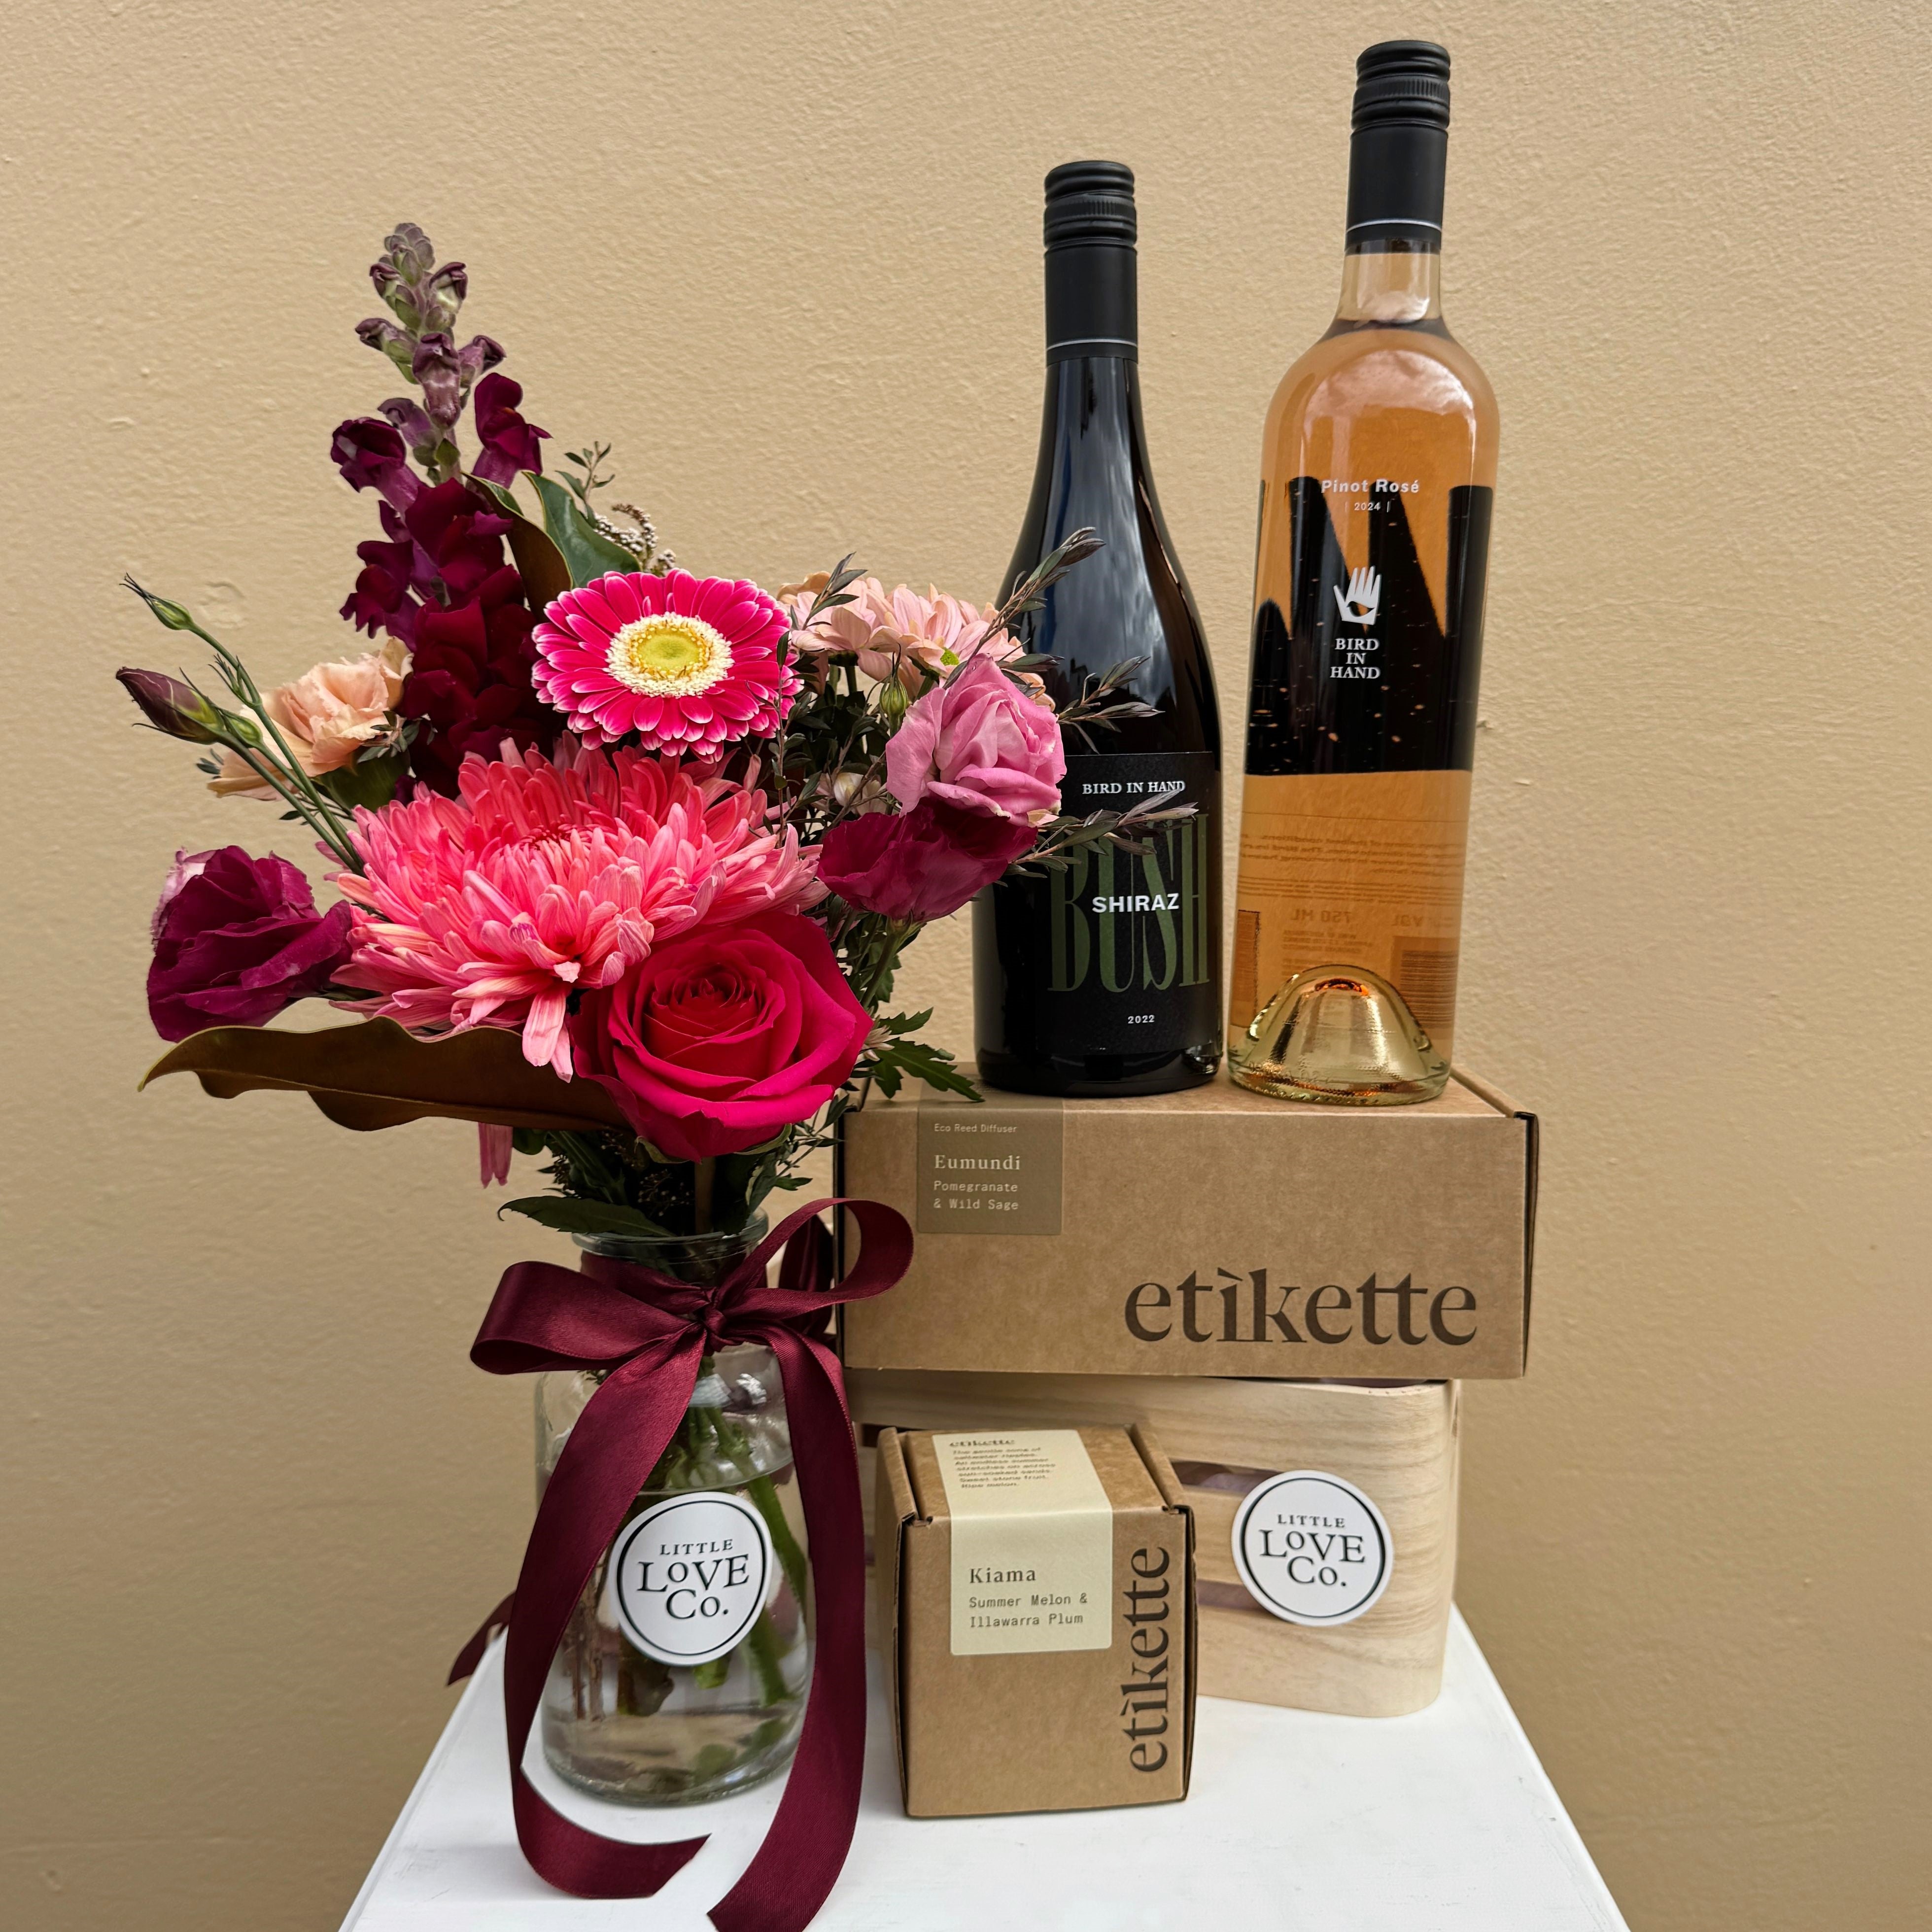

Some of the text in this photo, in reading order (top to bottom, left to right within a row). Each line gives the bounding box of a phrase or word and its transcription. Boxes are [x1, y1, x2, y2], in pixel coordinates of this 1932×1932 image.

[1321, 479, 1420, 493] Pinot Rosé
[1354, 502, 1381, 511] 2024
[1334, 638, 1380, 651] BIRD
[1346, 653, 1366, 665] IN
[1330, 666, 1380, 679] HAND
[1082, 781, 1185, 794] BIRD IN HAND
[1047, 814, 1209, 993] BUSH
[1092, 893, 1179, 913] SHIRAZ
[1127, 1014, 1155, 1024] 2022
[934, 1123, 1018, 1133] Eco Reed Diffuser
[934, 1155, 1020, 1170] Eumundi
[933, 1180, 1018, 1193] Pomegranate
[933, 1198, 1019, 1211] & Wild Sage
[1124, 1267, 1478, 1346] etìkette
[1277, 1514, 1346, 1528] LITTLE
[660, 1539, 733, 1555] LITTLE
[969, 1567, 1036, 1584] Kiama
[969, 1592, 1088, 1608] Summer Melon &
[969, 1613, 1083, 1628] Illawarra Plum
[1119, 1546, 1170, 1773] etìkette
